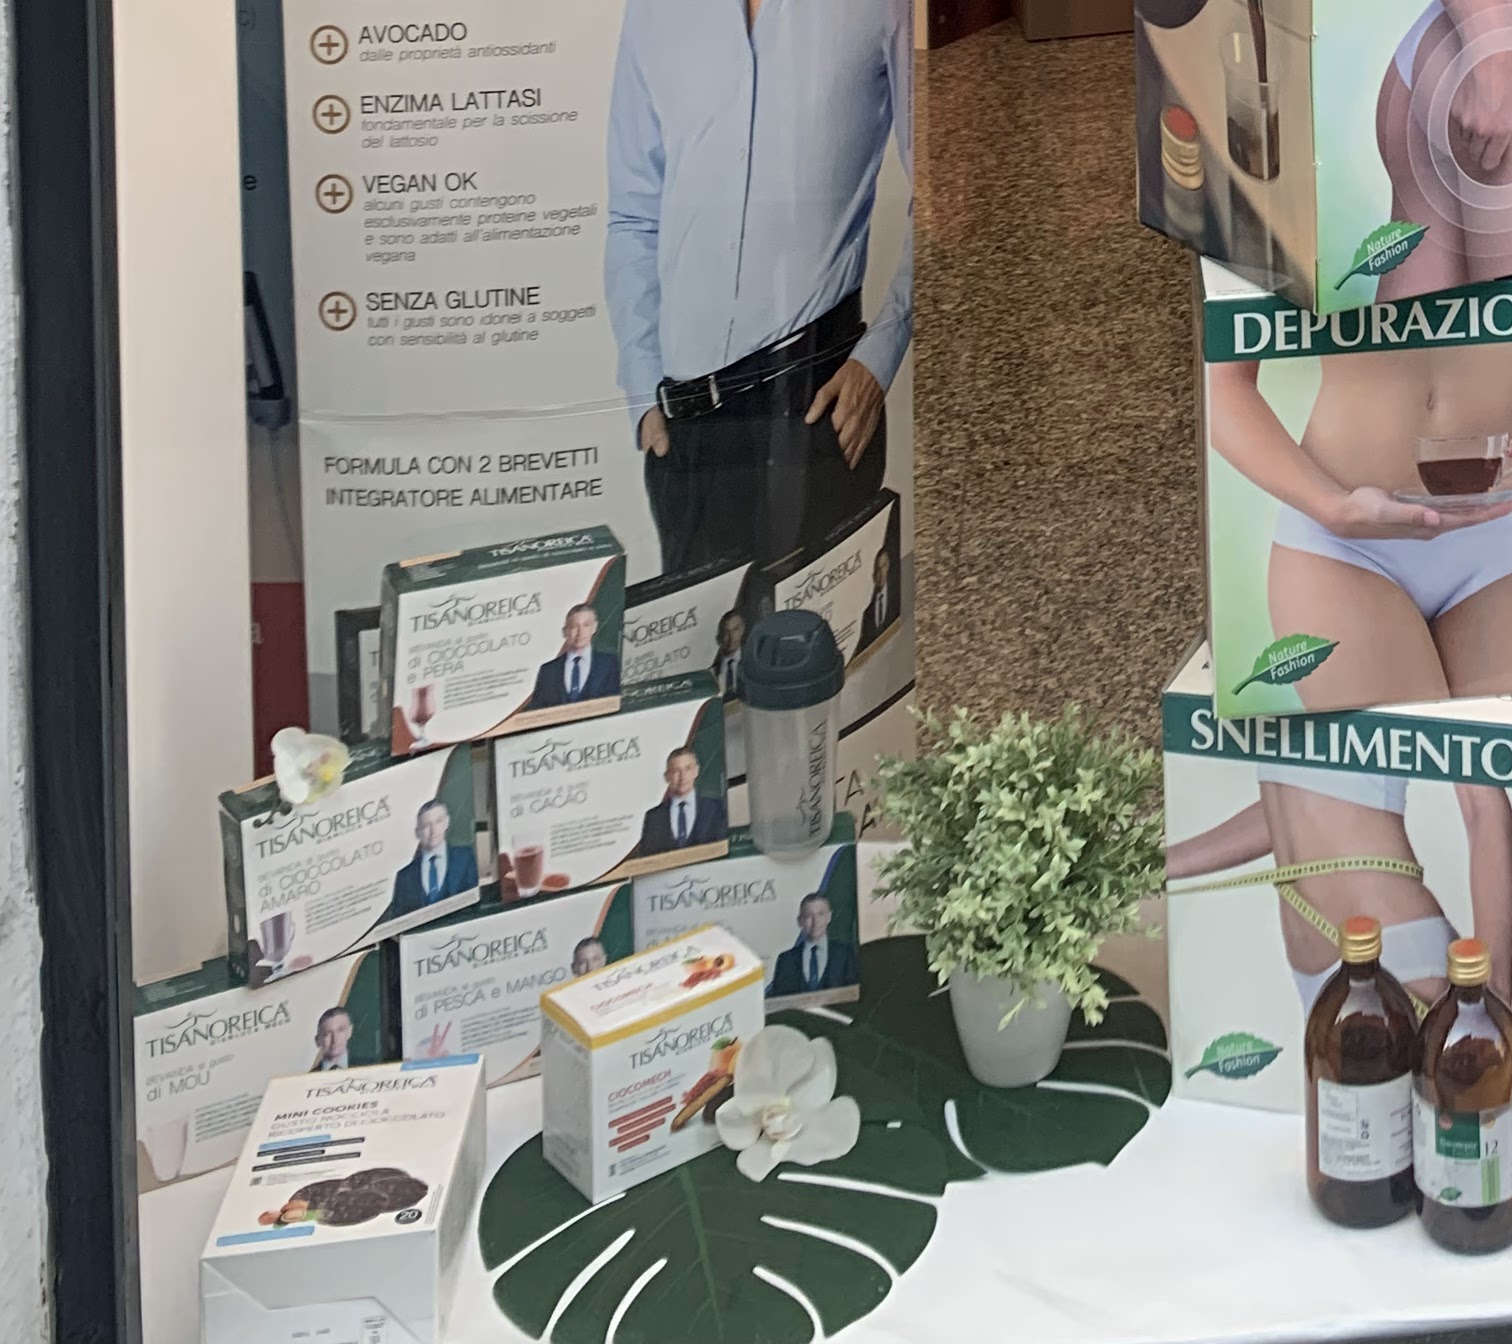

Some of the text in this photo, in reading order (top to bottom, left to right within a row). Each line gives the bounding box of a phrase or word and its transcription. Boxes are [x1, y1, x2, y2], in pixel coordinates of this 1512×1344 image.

[358, 21, 468, 45] AVOCADO
[360, 88, 542, 114] ENZIMA LATTASI
[362, 171, 479, 195] VEGAN OK
[1366, 227, 1403, 255] Nature
[1368, 238, 1409, 272] Fashion
[366, 286, 541, 312] SENZA GLUTINE
[324, 447, 599, 476] FORMULA CON 2 BREVETTI
[326, 478, 604, 508] INTEGRATORE ALIMENTARE
[410, 592, 541, 632] TISANOREICA
[1267, 639, 1308, 664] Nature
[1270, 651, 1315, 681] Fashion
[508, 736, 639, 778] TISANOREICA
[413, 928, 548, 977] TISANOREICA
[506, 967, 566, 994] MANGO
[146, 1001, 290, 1058] TISANOREICA
[629, 1012, 733, 1069] TISANOREICA
[168, 1071, 212, 1096] MOU
[275, 1101, 378, 1121] MINI COOKIES
